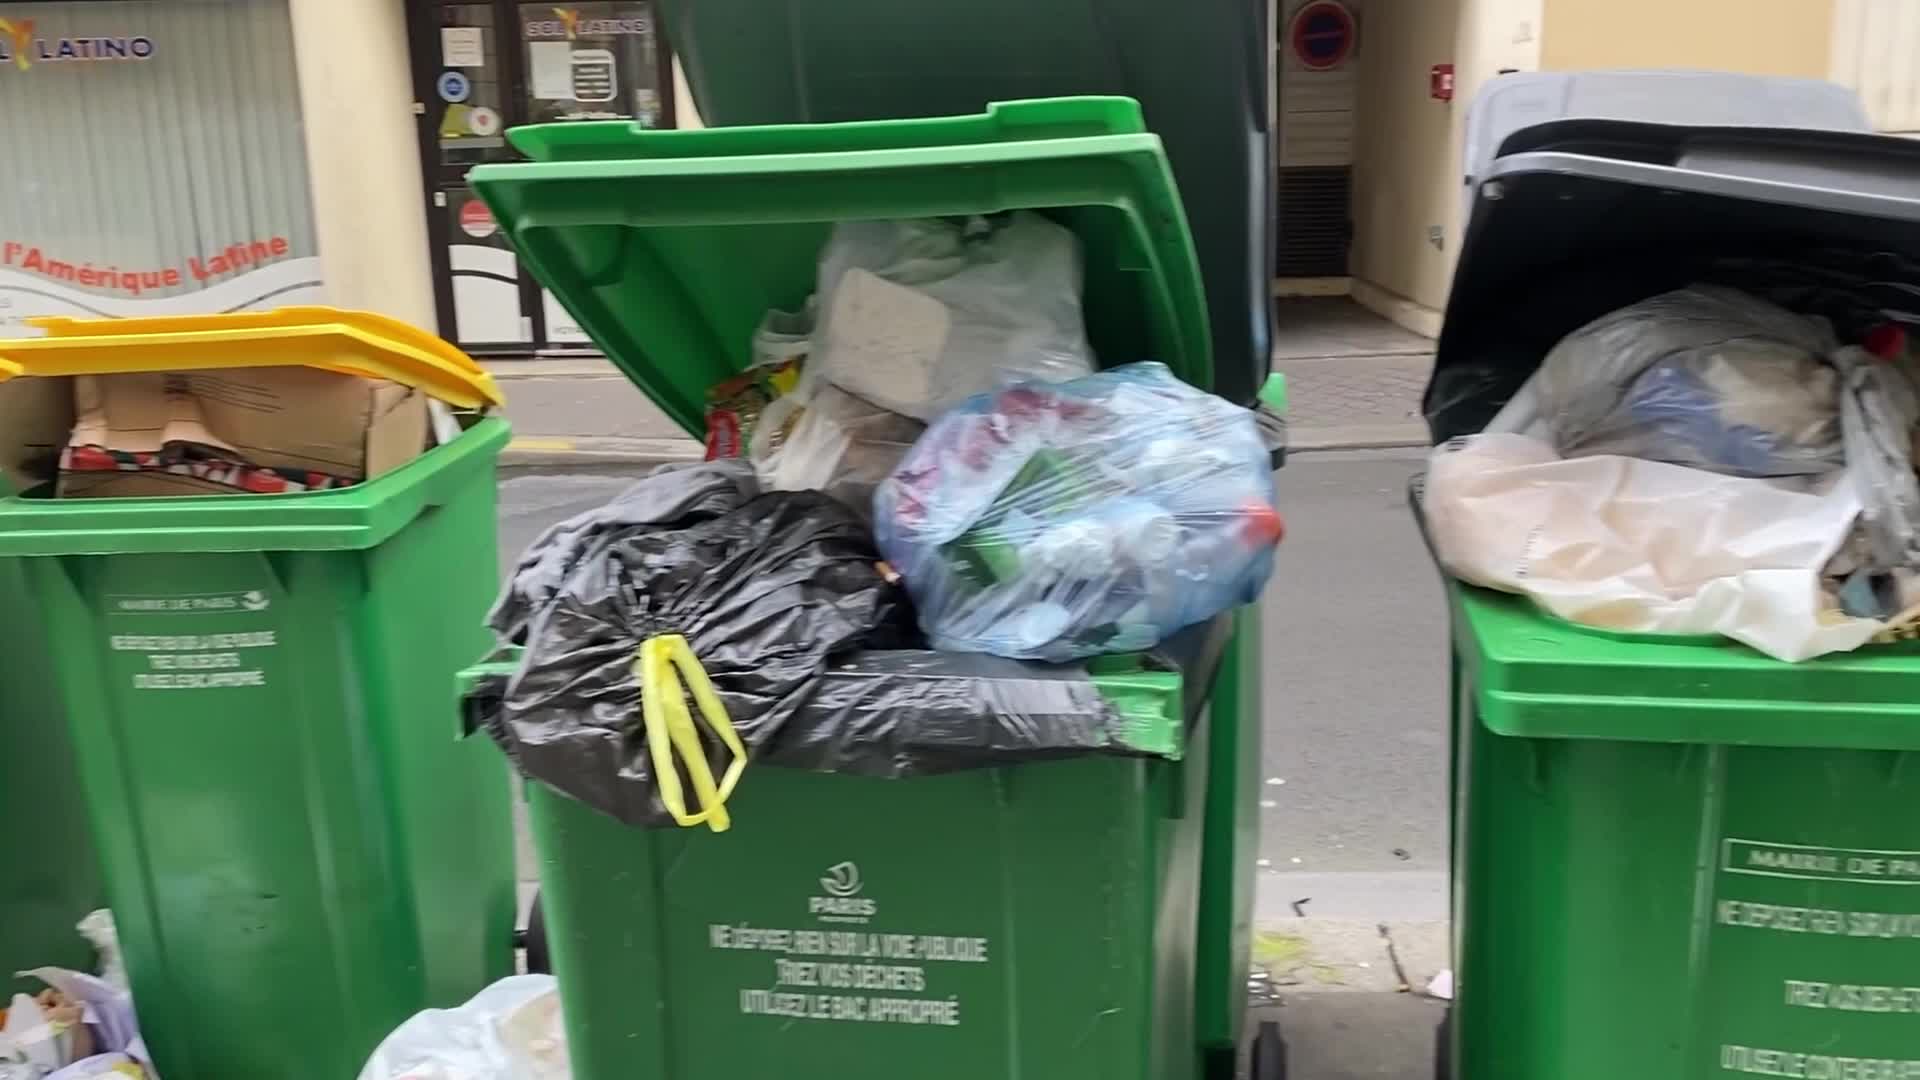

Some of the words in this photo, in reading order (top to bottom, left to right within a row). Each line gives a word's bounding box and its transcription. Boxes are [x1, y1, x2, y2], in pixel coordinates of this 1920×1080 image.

[577, 18, 647, 35] LATINO
[36, 37, 154, 60] LATINO
[188, 236, 288, 281] Latine
[1847, 857, 1885, 875] DE
[808, 897, 878, 915] PARIS
